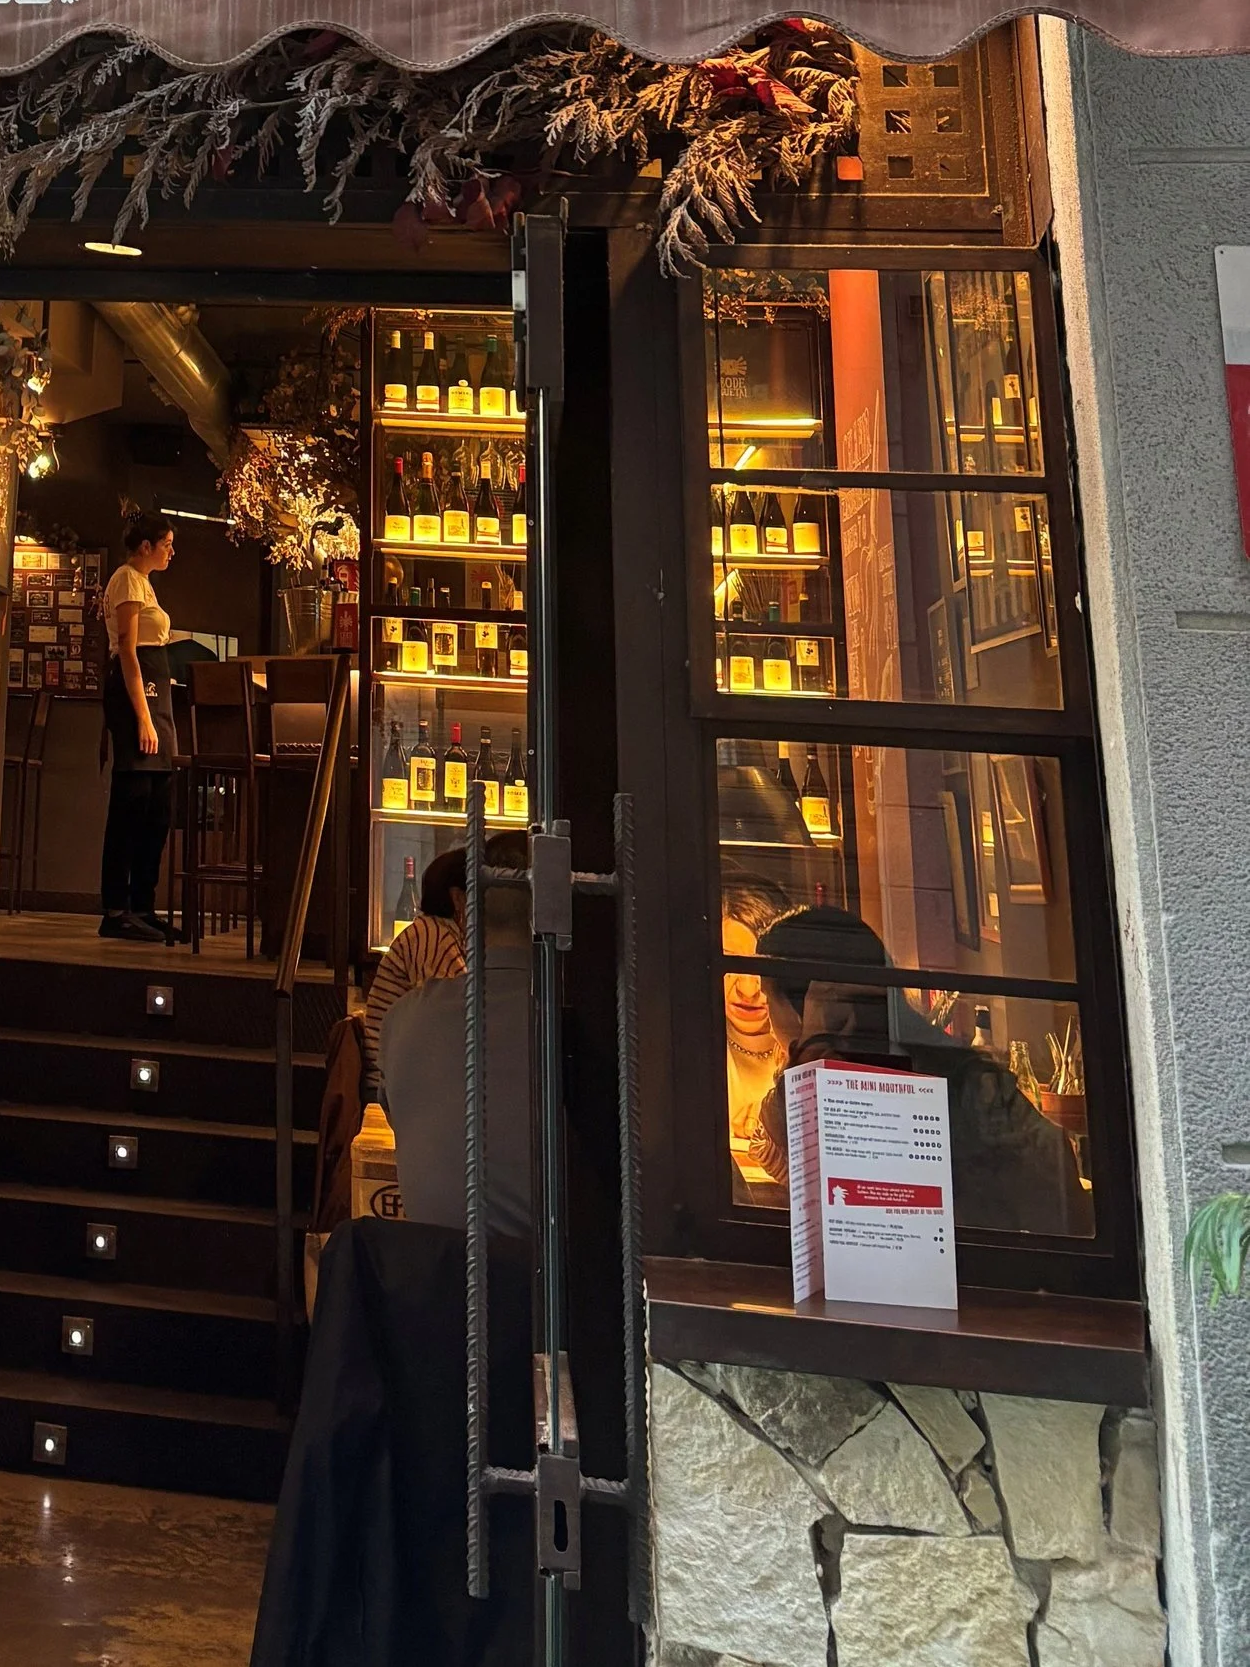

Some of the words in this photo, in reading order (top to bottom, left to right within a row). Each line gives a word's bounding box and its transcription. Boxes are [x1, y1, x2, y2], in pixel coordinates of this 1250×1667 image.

[845, 1079, 859, 1091] THE
[860, 1080, 877, 1093] MINI
[878, 1082, 916, 1095] MOUTHFUL
